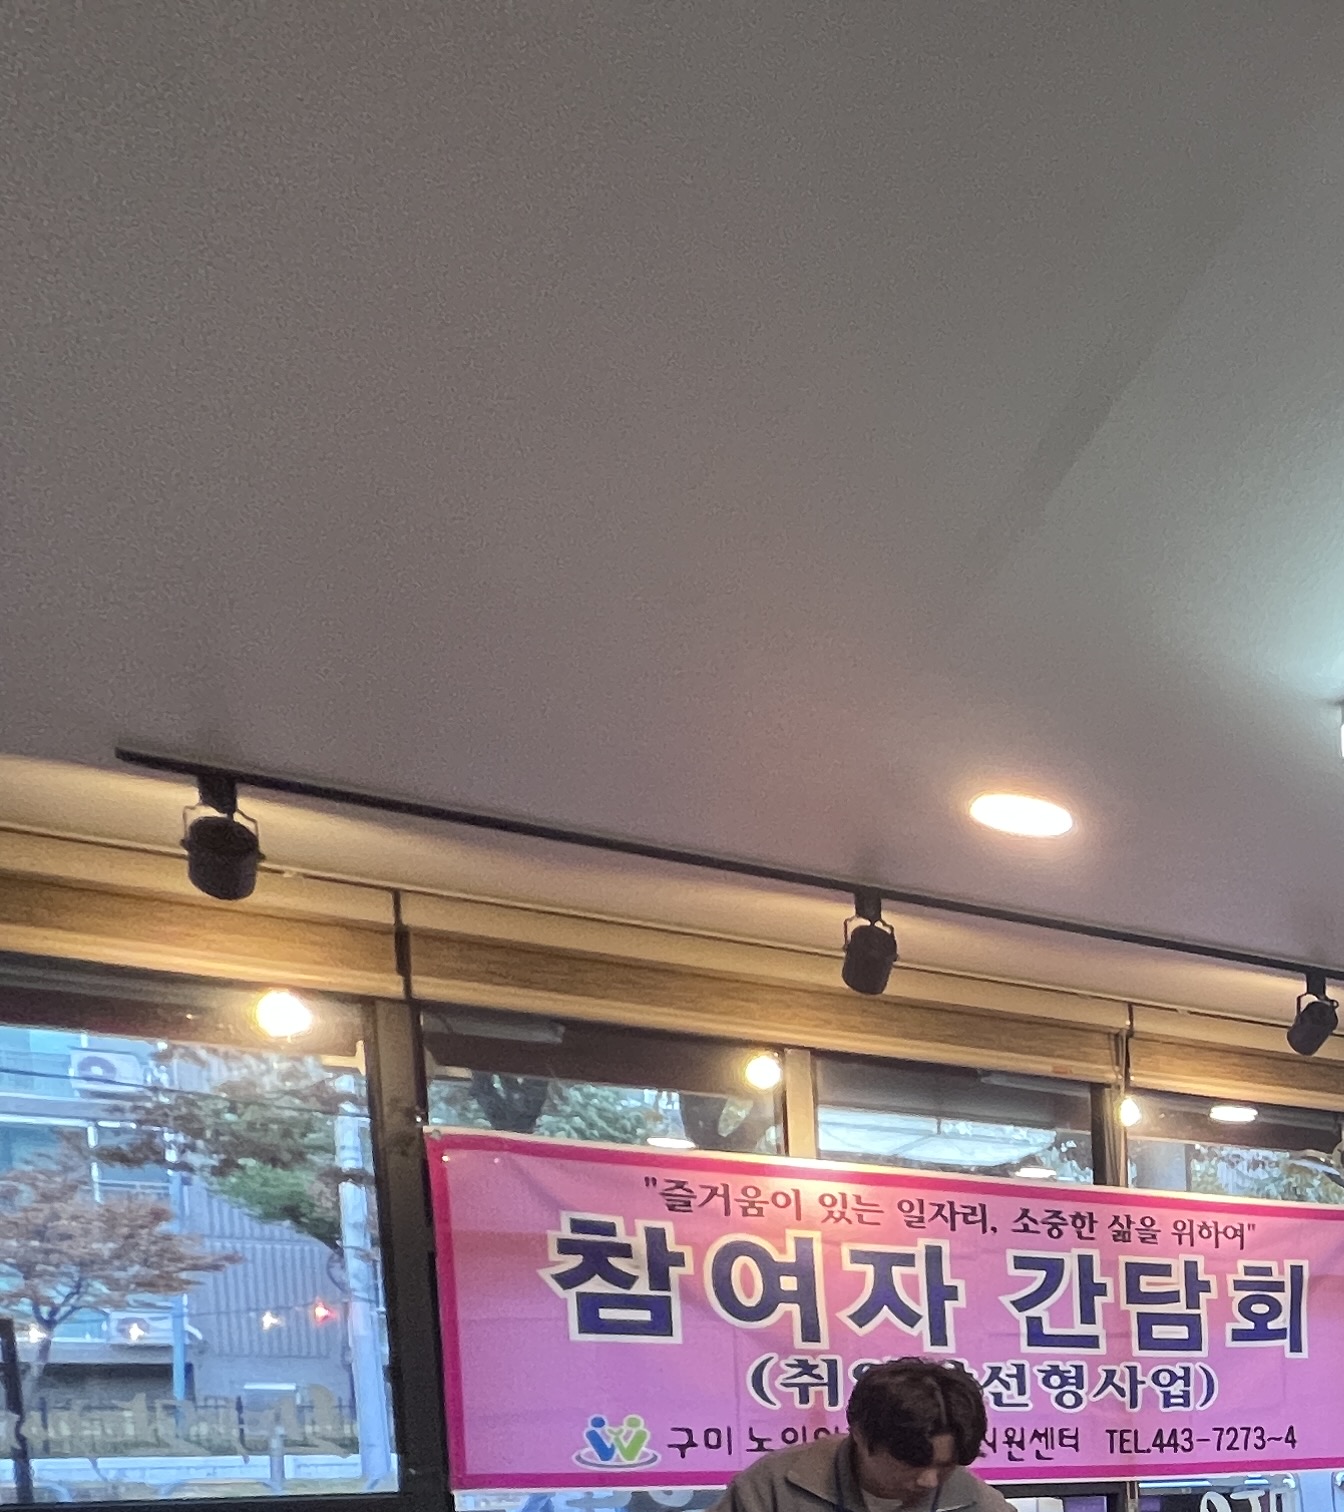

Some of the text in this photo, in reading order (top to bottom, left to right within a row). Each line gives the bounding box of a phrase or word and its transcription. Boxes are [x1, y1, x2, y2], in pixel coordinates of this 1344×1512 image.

[644, 1176, 1257, 1250] "즐거움이 있는 일자리, 소중한 삶을 위하여"
[545, 1213, 1306, 1355] 참여자 간담회
[749, 1355, 1216, 1412] (취선형사업)
[667, 1426, 732, 1459] 구미
[1105, 1424, 1298, 1455] TEL.443-7273~4
